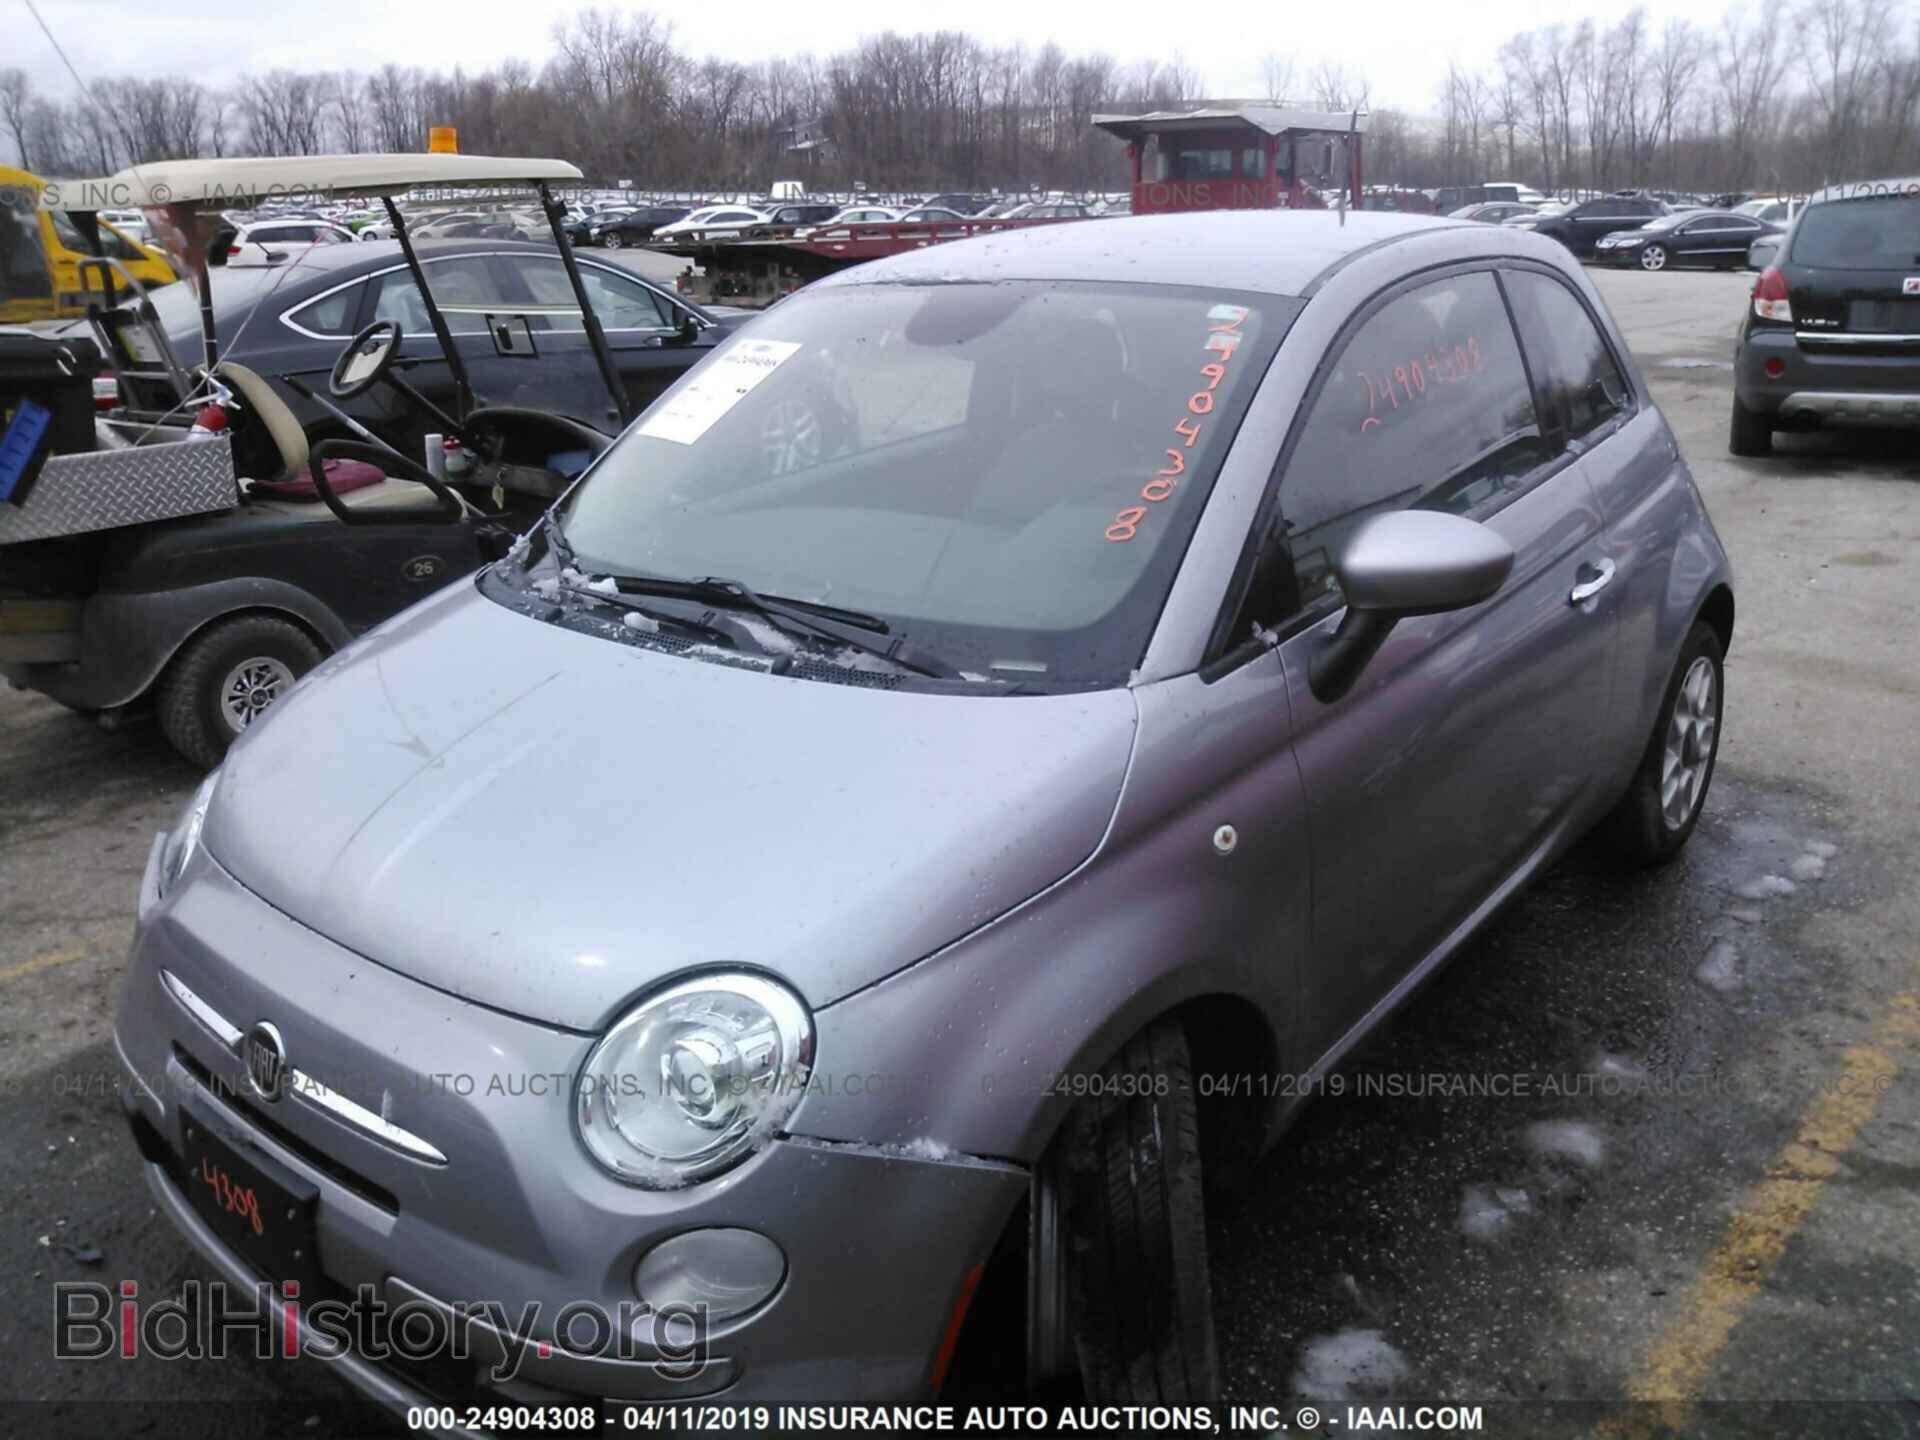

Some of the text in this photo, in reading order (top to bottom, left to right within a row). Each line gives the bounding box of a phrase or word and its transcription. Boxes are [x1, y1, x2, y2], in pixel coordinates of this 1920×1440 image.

[1105, 306, 1249, 541] 24904308
[252, 1041, 277, 1083] FIAT
[202, 1156, 263, 1235] 4308
